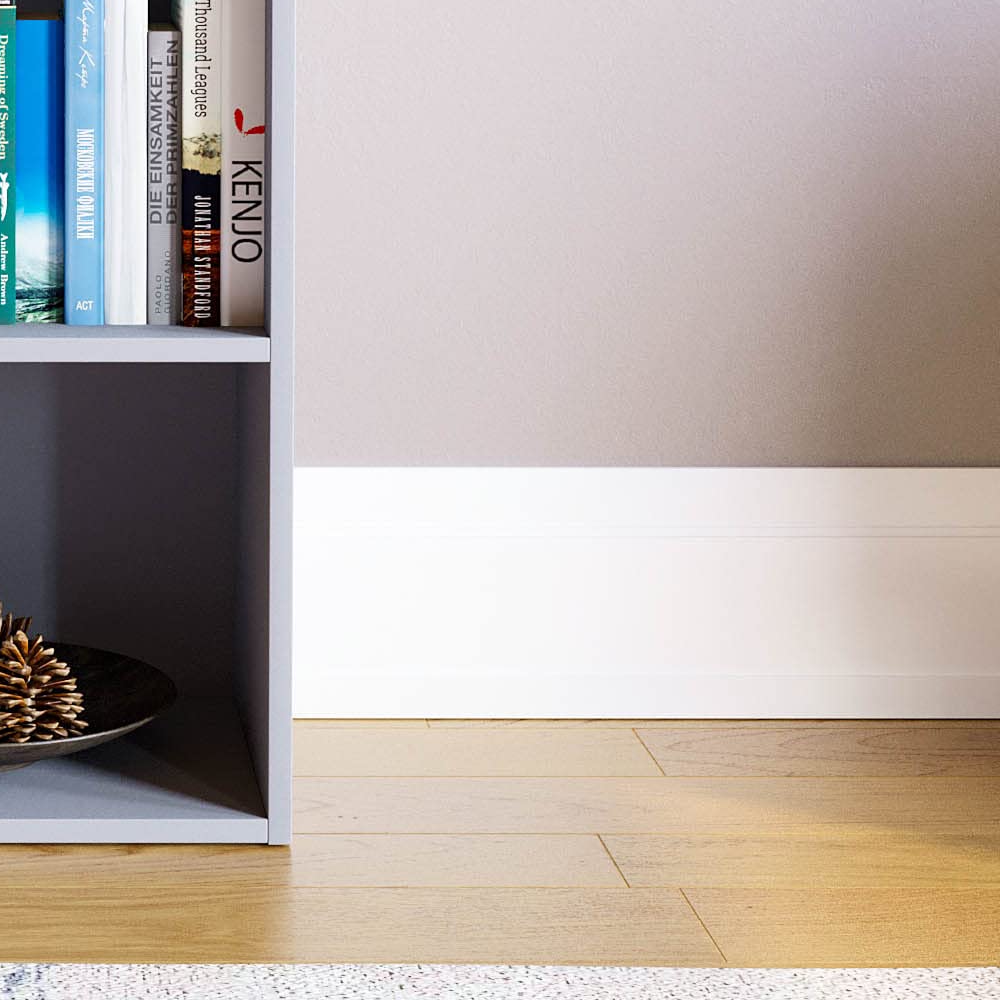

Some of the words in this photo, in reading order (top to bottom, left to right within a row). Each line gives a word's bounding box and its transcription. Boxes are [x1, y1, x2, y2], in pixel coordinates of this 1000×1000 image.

[194, 0, 211, 62] Thousand
[0, 97, 10, 110] of
[166, 39, 179, 176] PRIMZAHLEN
[190, 66, 211, 118] Leagues
[0, 112, 9, 160] Sweden
[150, 57, 163, 184] EINSAMKEIT
[76, 128, 95, 193] МОСКОВСКИЕ
[76, 195, 95, 240] ФИАЛКИ
[150, 191, 163, 225] DIE
[166, 182, 179, 225] DER
[193, 195, 212, 251] JONATHAN
[231, 160, 263, 263] KENJO
[0, 233, 8, 272] Andrew
[0, 274, 8, 305] Brown
[193, 256, 212, 319] STANDFORD
